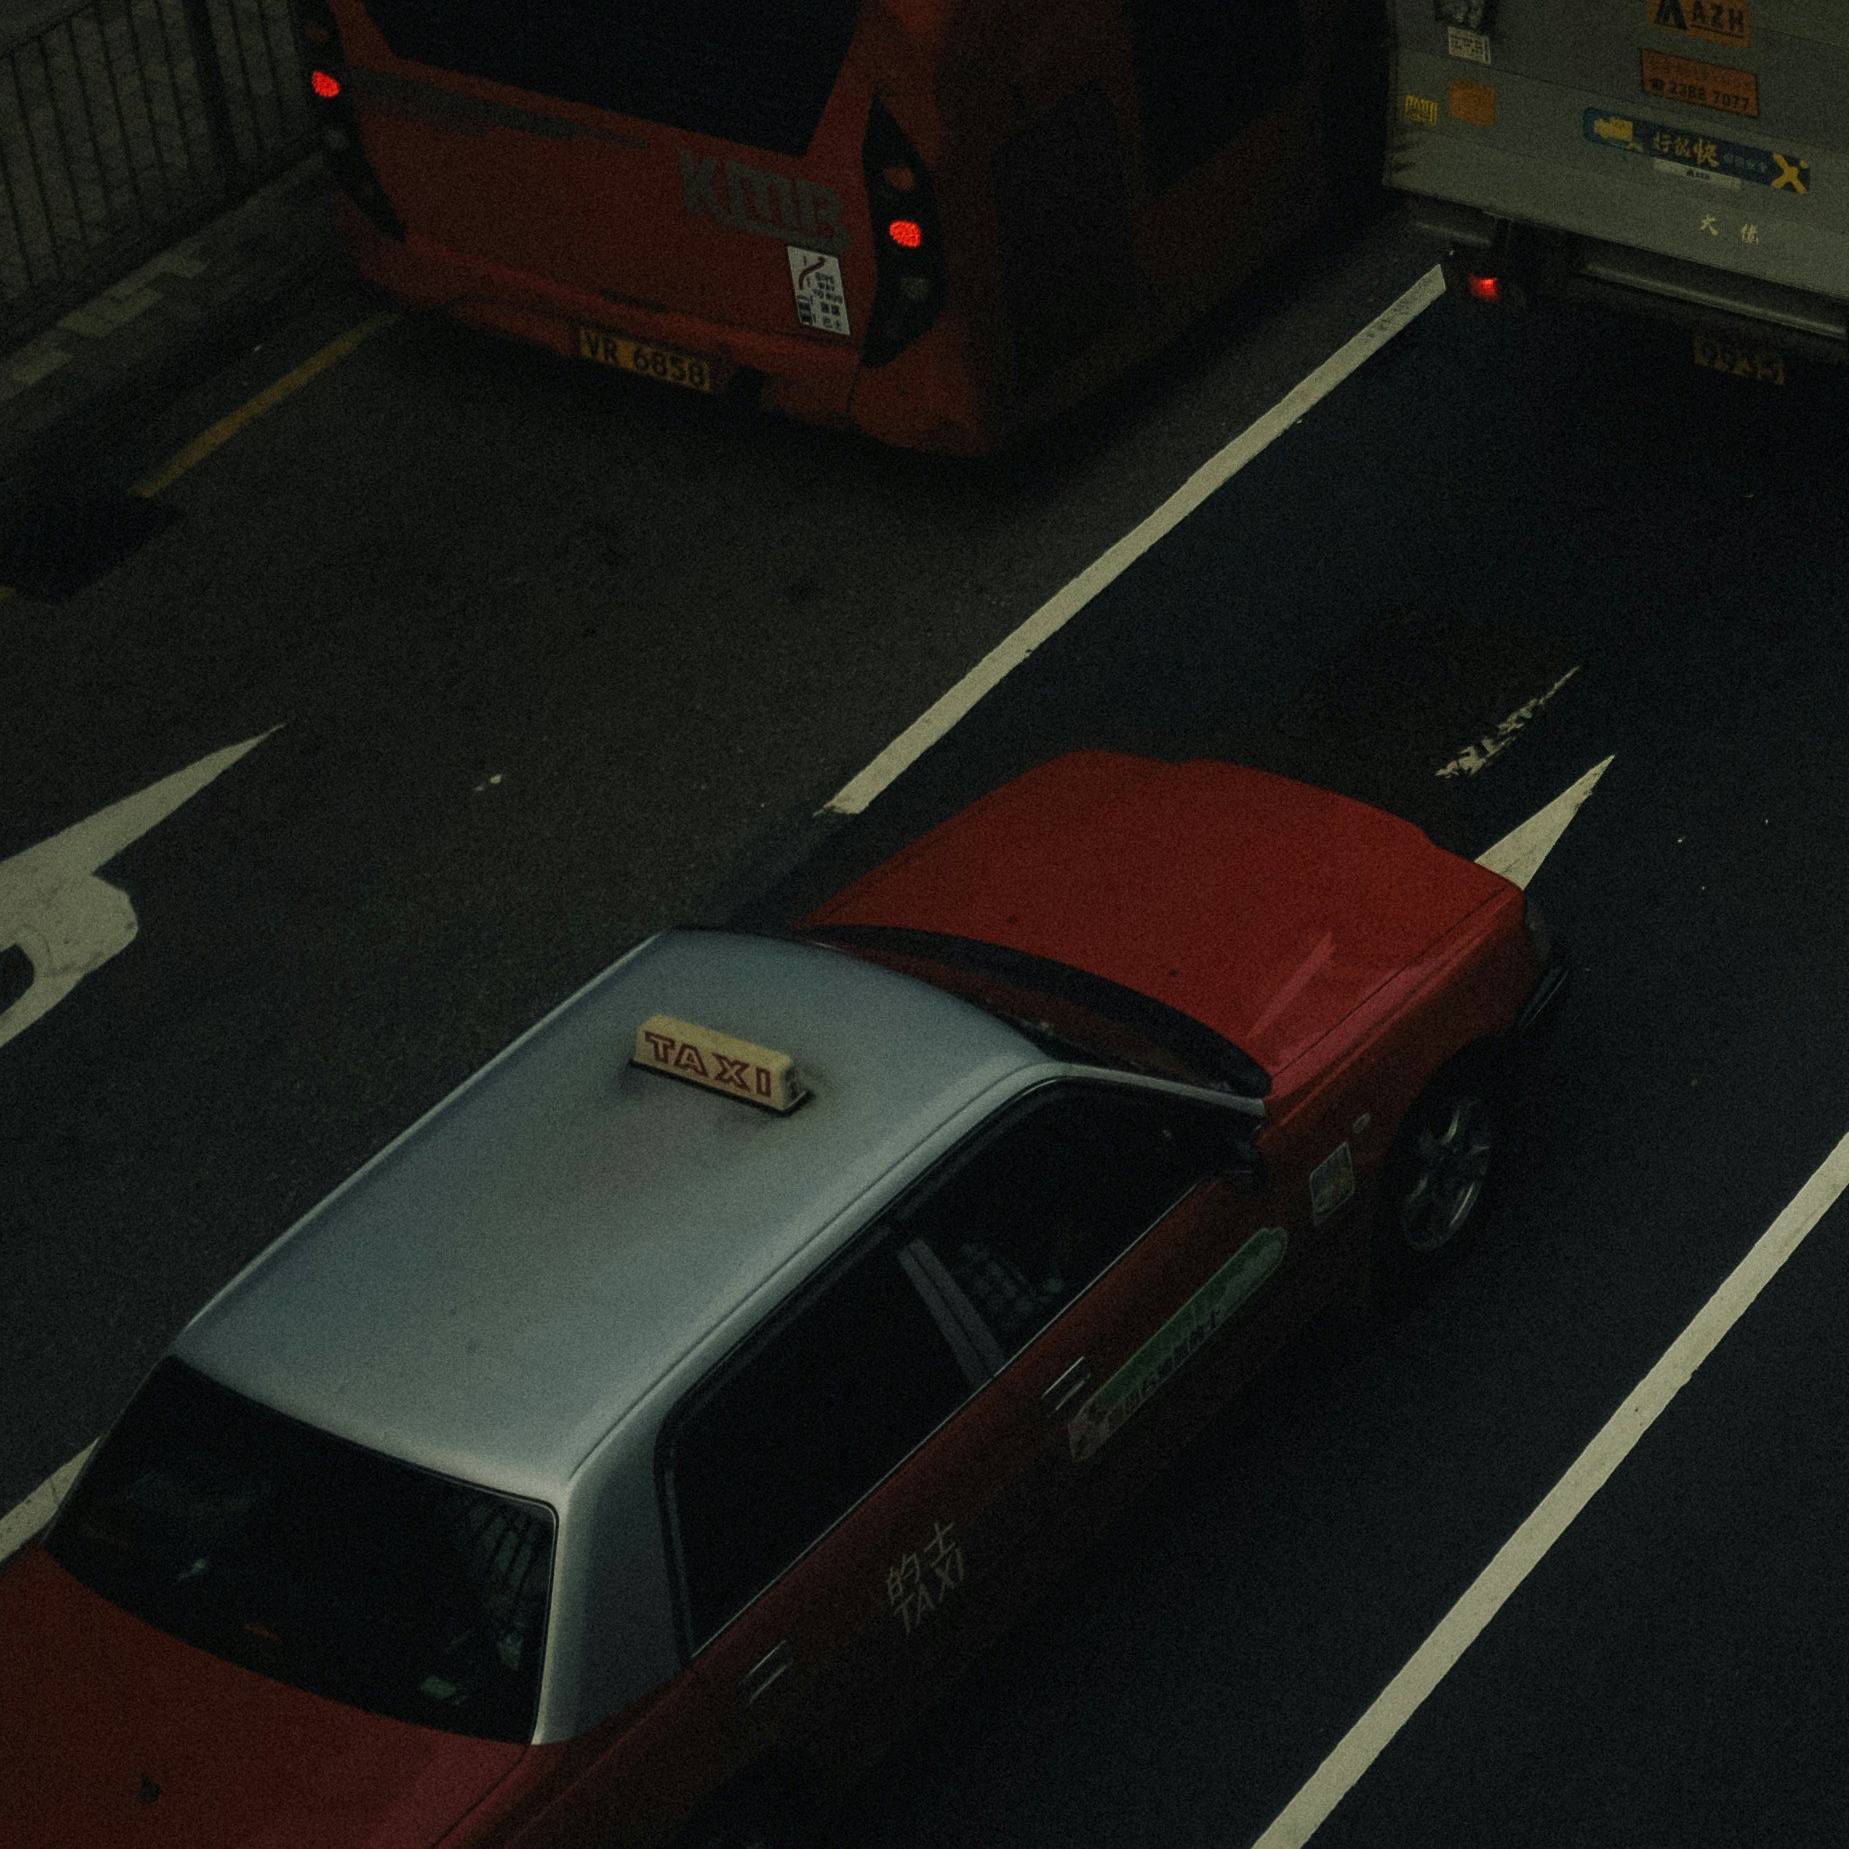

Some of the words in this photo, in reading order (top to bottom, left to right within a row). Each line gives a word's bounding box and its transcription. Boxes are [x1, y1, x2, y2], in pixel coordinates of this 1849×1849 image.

[1691, 0, 1745, 32] AZH
[677, 150, 852, 257] KMB
[580, 326, 619, 361] VR
[633, 345, 707, 387] 6858
[643, 1030, 775, 1099] TAXI
[885, 1520, 957, 1607] 的士
[892, 1548, 965, 1636] TAXI
